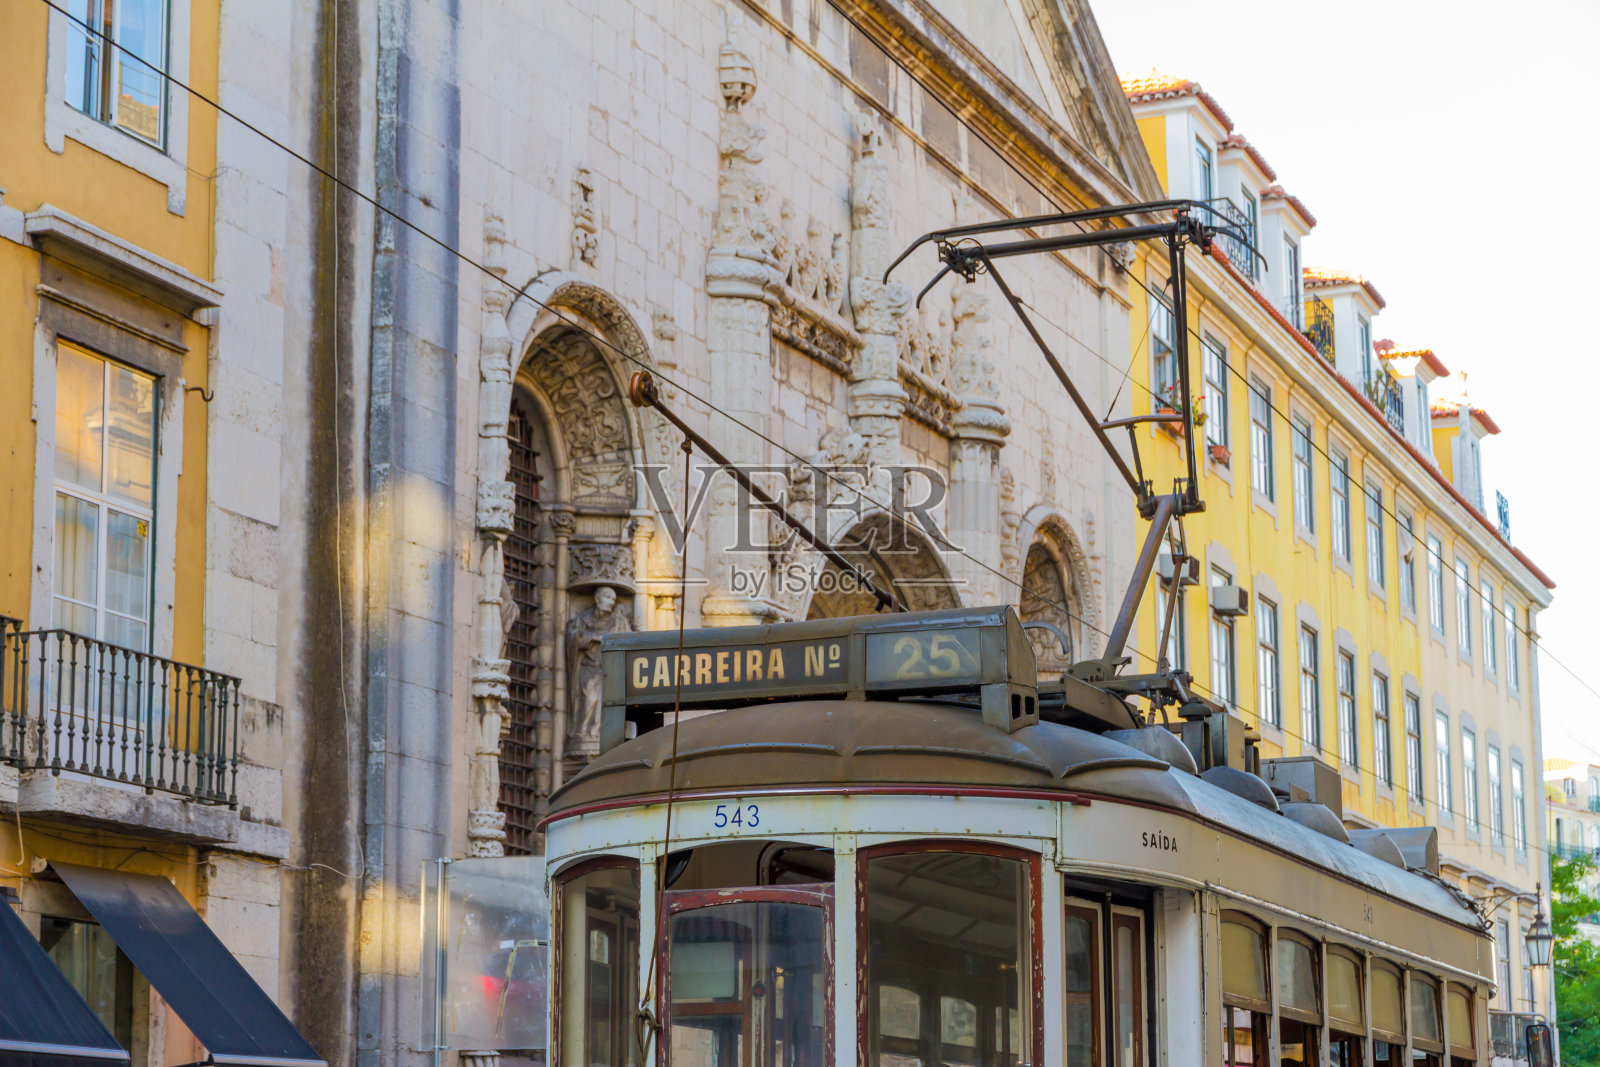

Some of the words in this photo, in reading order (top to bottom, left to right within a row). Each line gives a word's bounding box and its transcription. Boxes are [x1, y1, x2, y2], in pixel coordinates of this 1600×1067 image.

[632, 647, 785, 690] CARREIRA
[893, 634, 961, 680] 25
[714, 804, 760, 828] 543
[1142, 829, 1178, 853] SAÍDA
